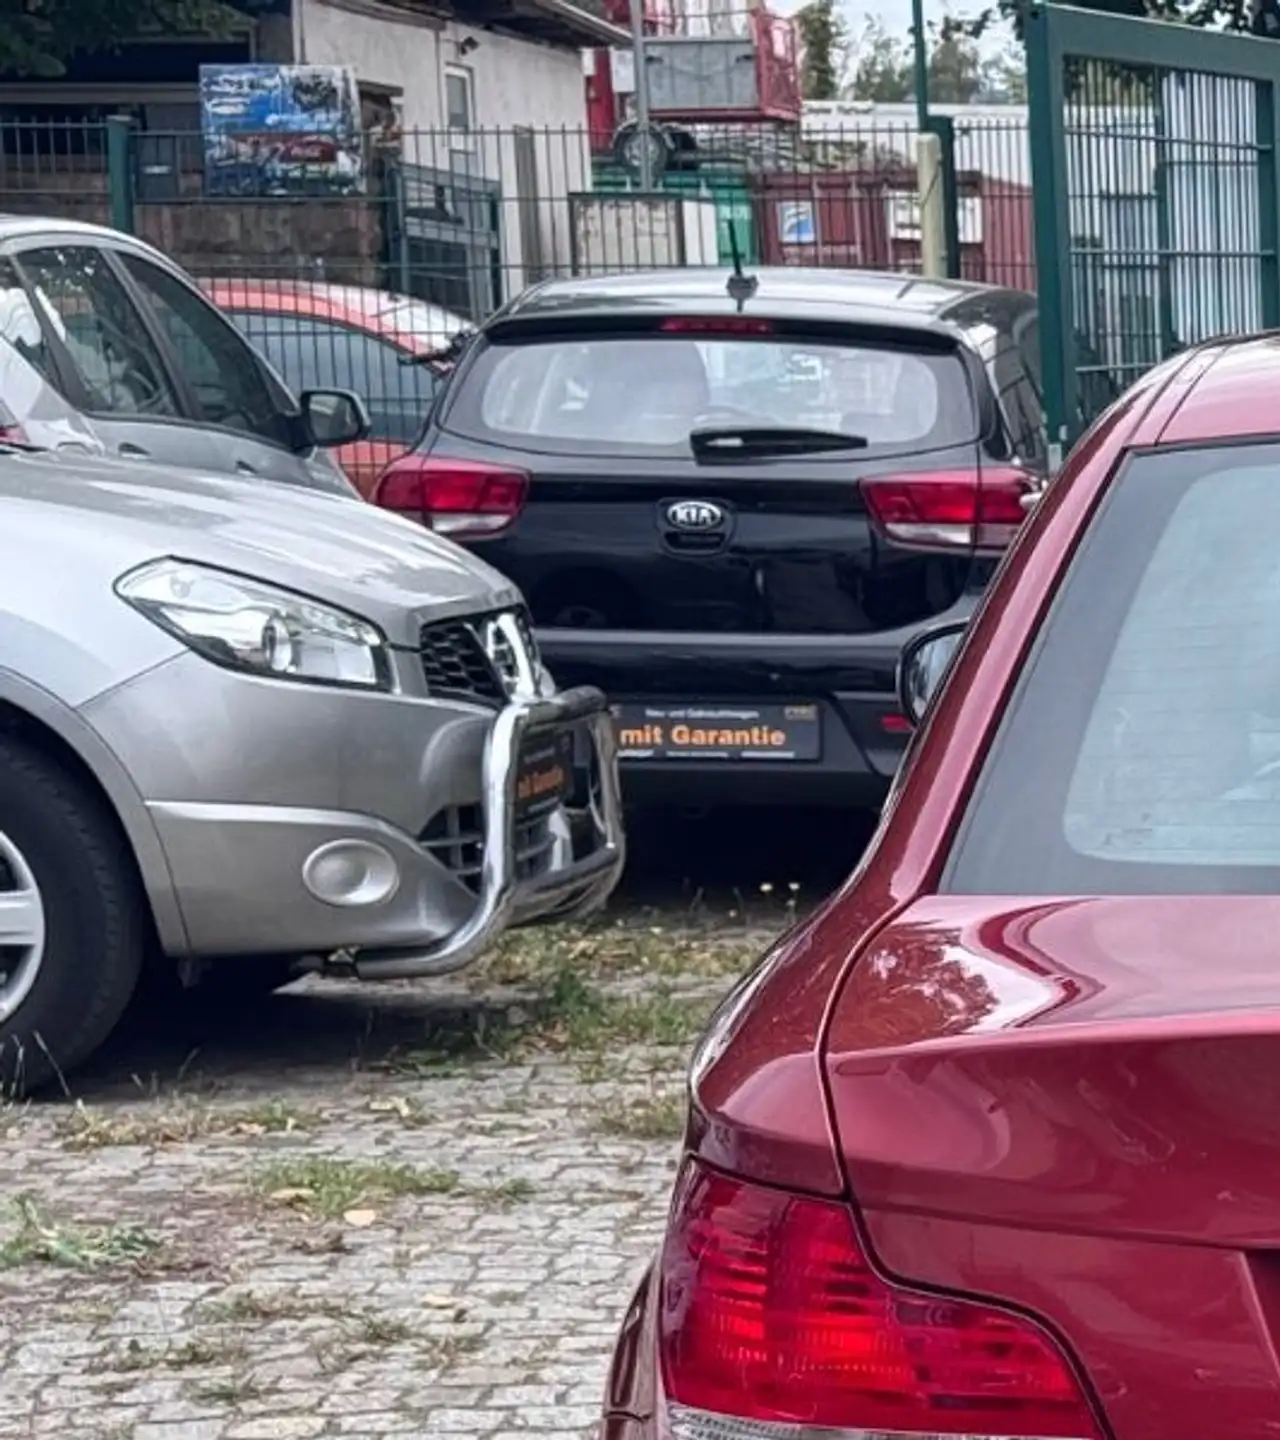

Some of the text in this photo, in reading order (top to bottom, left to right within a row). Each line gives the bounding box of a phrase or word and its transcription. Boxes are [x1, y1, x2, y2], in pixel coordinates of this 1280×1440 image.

[672, 504, 718, 527] KIA
[620, 724, 787, 746] mit Garantie
